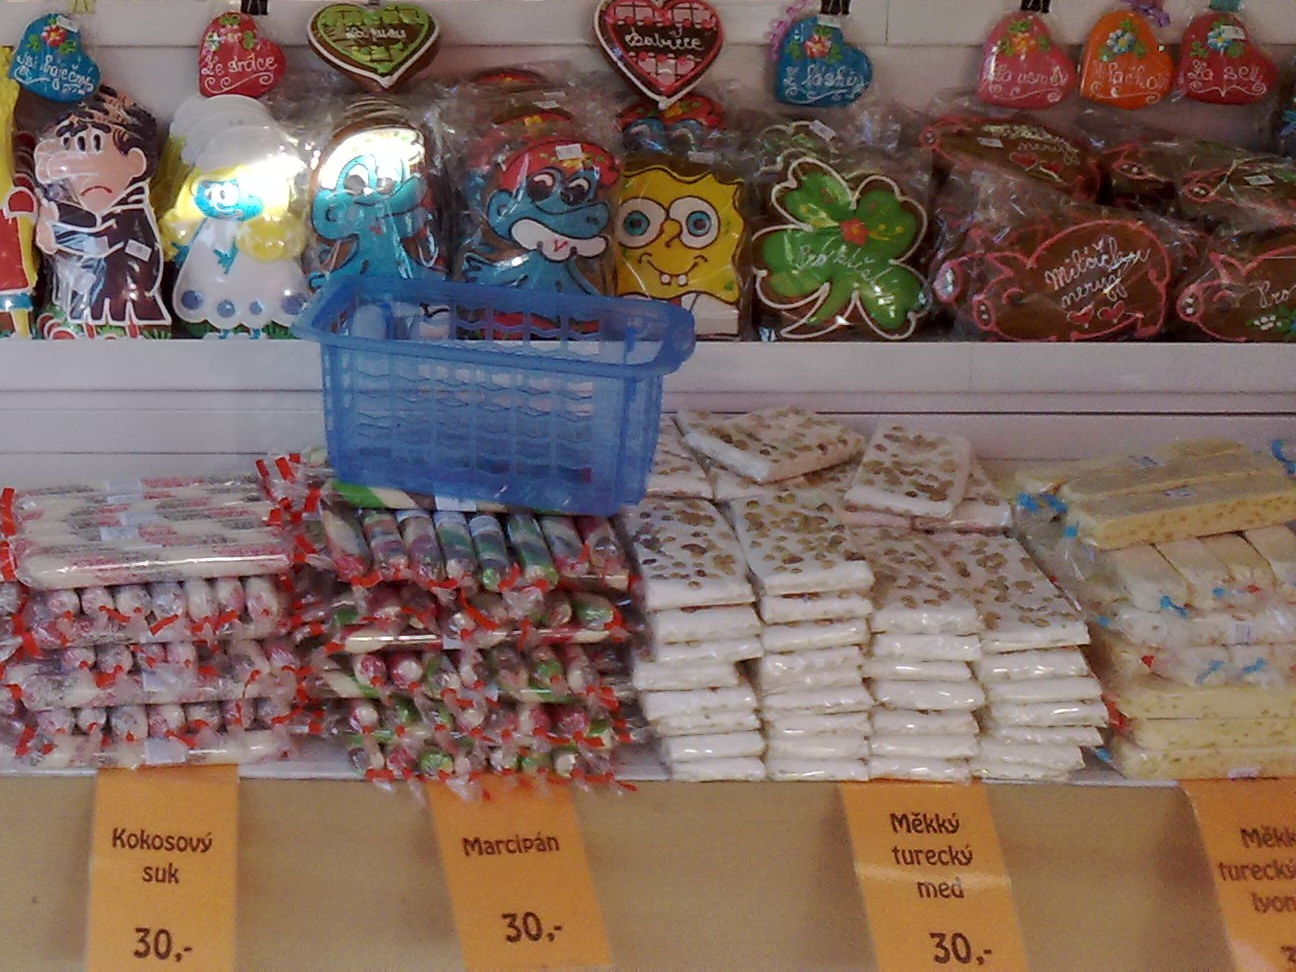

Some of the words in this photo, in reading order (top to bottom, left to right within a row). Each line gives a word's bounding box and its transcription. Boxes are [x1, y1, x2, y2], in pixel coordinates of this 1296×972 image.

[228, 53, 279, 76] srdce
[890, 812, 961, 834] Měkký
[112, 827, 213, 853] Kokosový
[462, 831, 561, 856] Marcipán
[892, 846, 974, 867] turecký
[142, 863, 179, 885] suk
[917, 879, 965, 899] med
[501, 912, 563, 944] 30,-
[133, 928, 193, 961] 30,-
[930, 932, 993, 965] 30,-
